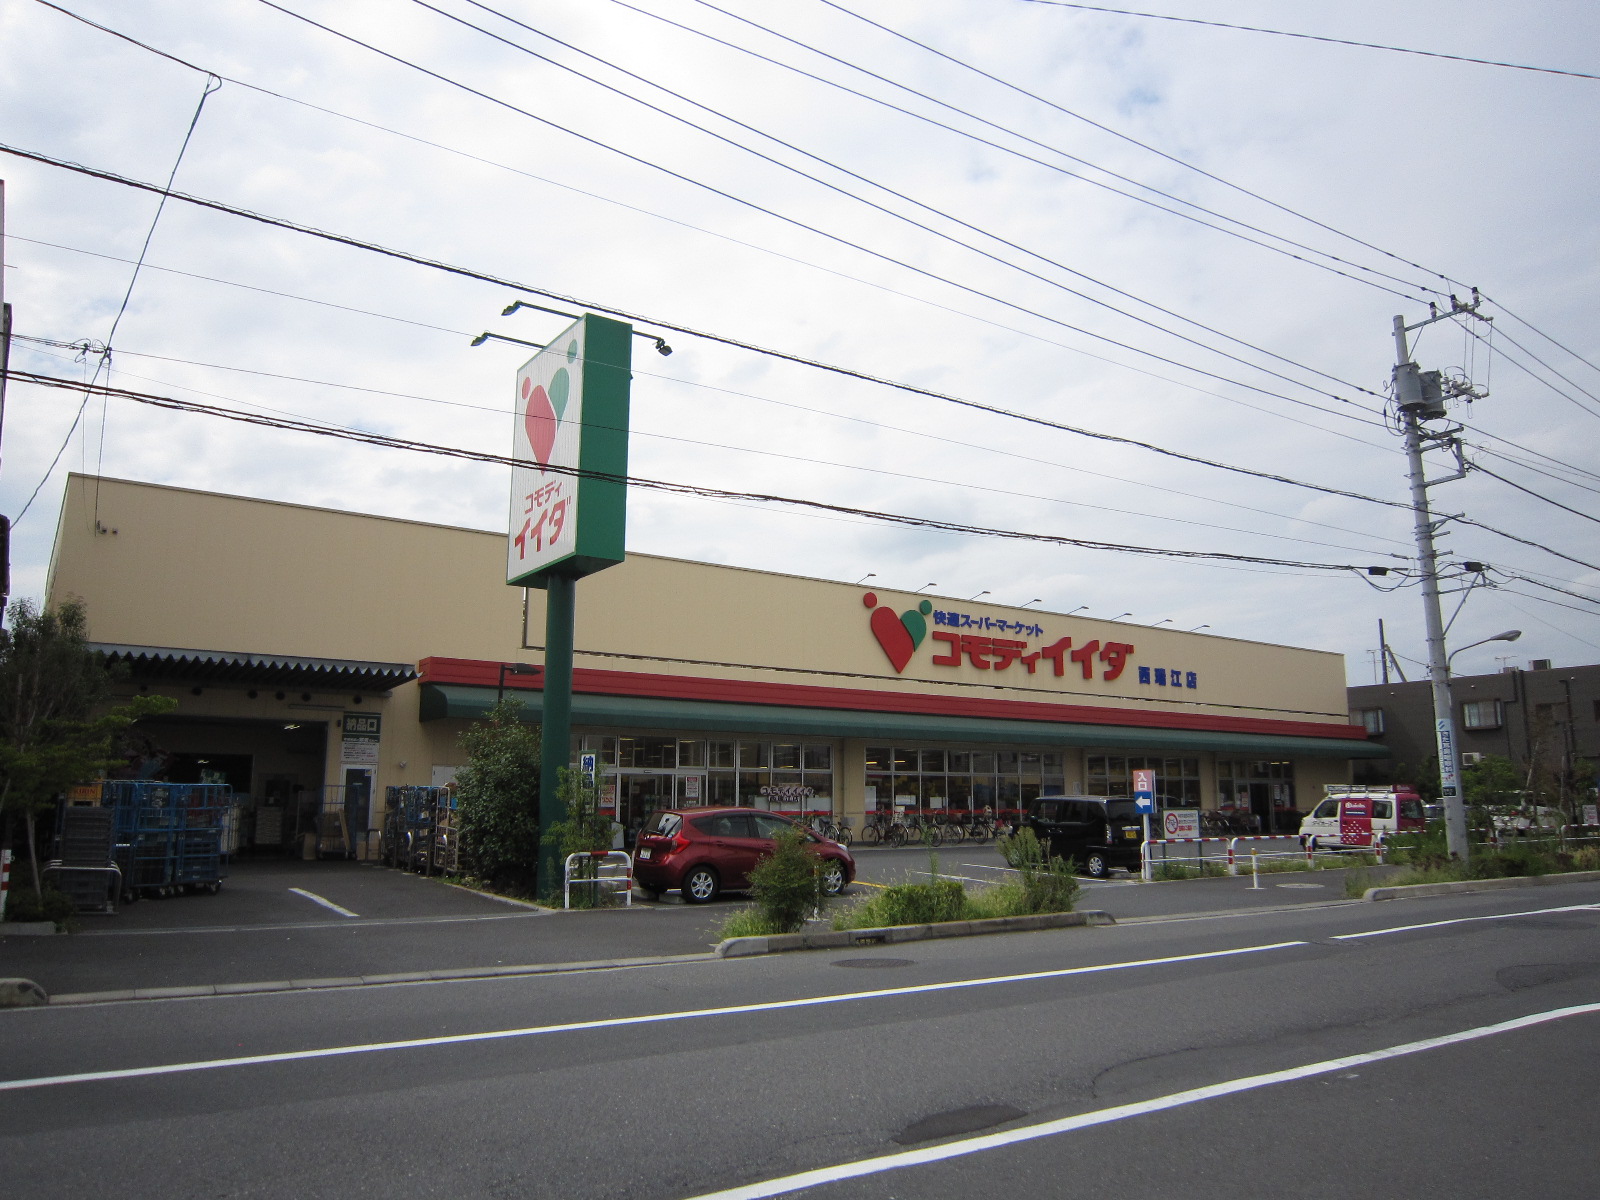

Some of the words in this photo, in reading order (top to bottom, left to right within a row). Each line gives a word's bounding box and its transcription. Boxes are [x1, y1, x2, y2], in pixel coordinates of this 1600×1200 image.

[525, 480, 563, 514] コモディ
[515, 495, 571, 560] イイダ
[933, 610, 1043, 637] 快適スーパーマーケット
[932, 630, 1134, 681] コモディイイダ
[1137, 772, 1148, 790] 入口
